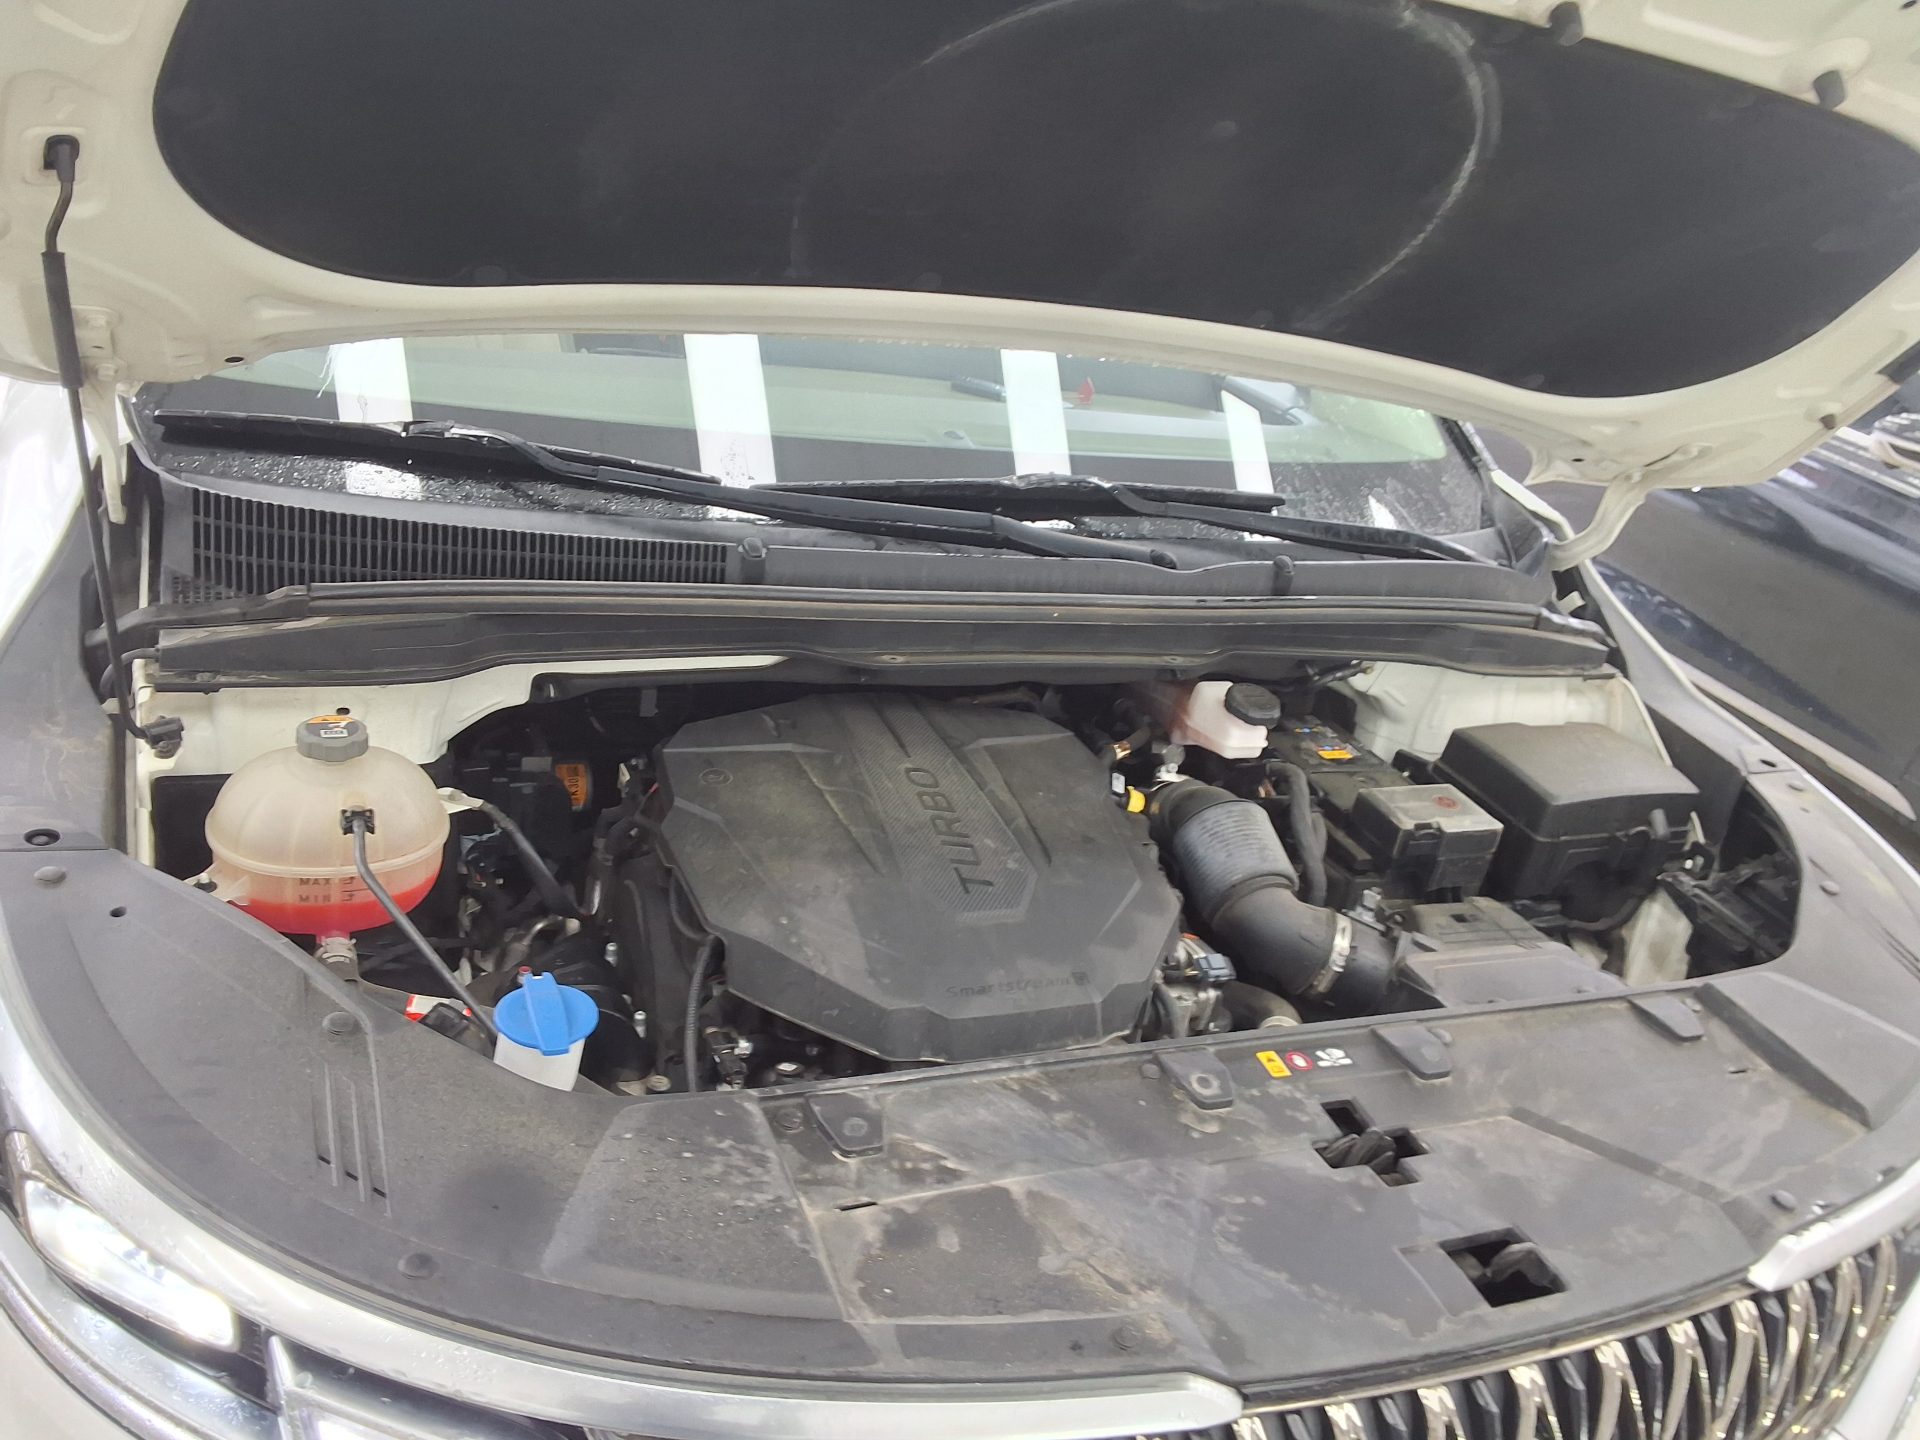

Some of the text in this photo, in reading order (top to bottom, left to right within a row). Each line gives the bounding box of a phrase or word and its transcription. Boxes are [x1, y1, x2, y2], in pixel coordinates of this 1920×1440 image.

[904, 767, 995, 894] TURBO
[299, 877, 332, 887] MAX
[299, 894, 332, 903] MIN
